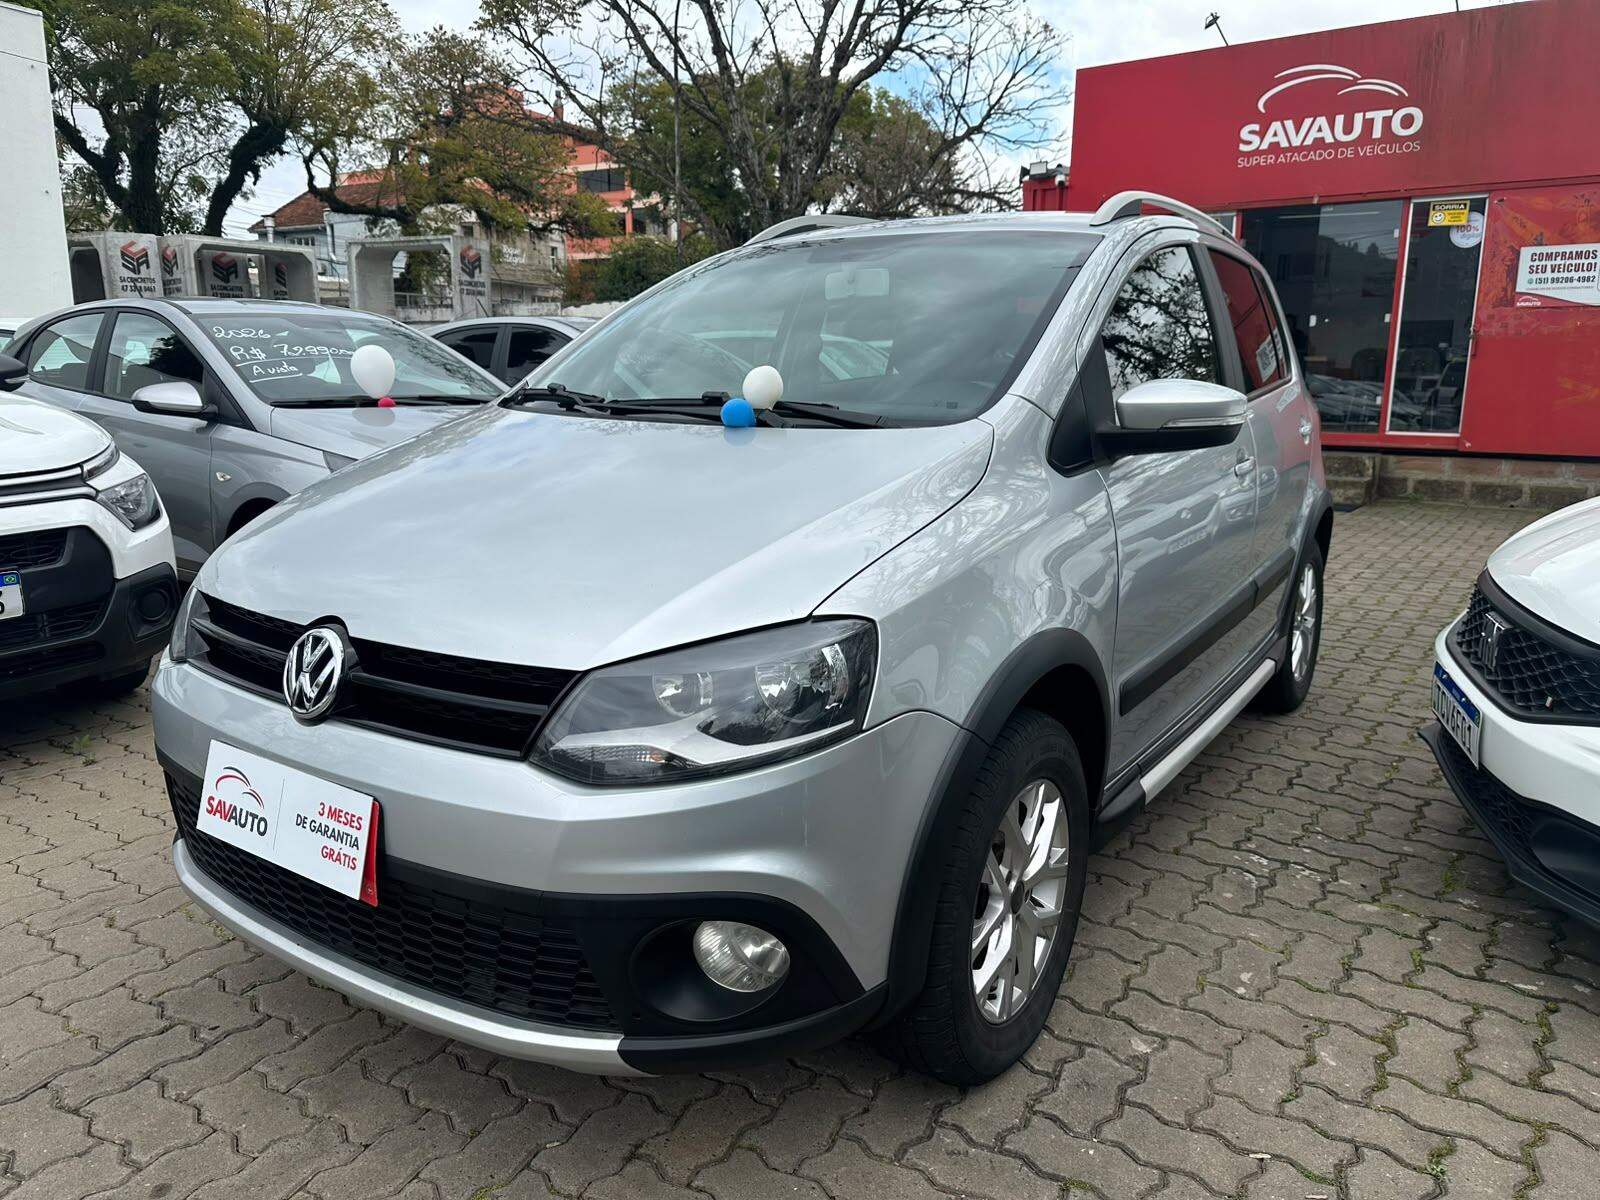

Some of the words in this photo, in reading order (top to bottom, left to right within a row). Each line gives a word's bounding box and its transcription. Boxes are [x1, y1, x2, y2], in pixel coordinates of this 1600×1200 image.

[1239, 106, 1424, 152] SAVAUTO
[1237, 155, 1275, 168] SUPER
[1276, 149, 1335, 164] ATACADO
[1337, 147, 1355, 159] DE
[1357, 141, 1421, 156] VEÍCULOS
[1528, 263, 1548, 274] SEU
[1550, 261, 1597, 274] VEÍCULO!
[1530, 249, 1598, 262] COMPRAMOS
[212, 326, 271, 339] 2026
[229, 345, 267, 360] R$
[206, 795, 268, 837] SAVAUTO
[318, 802, 325, 817] 3
[327, 805, 363, 831] MESES
[295, 813, 308, 830] DE
[309, 819, 360, 850] GARANTIA
[320, 845, 357, 871] GRÁTIS
